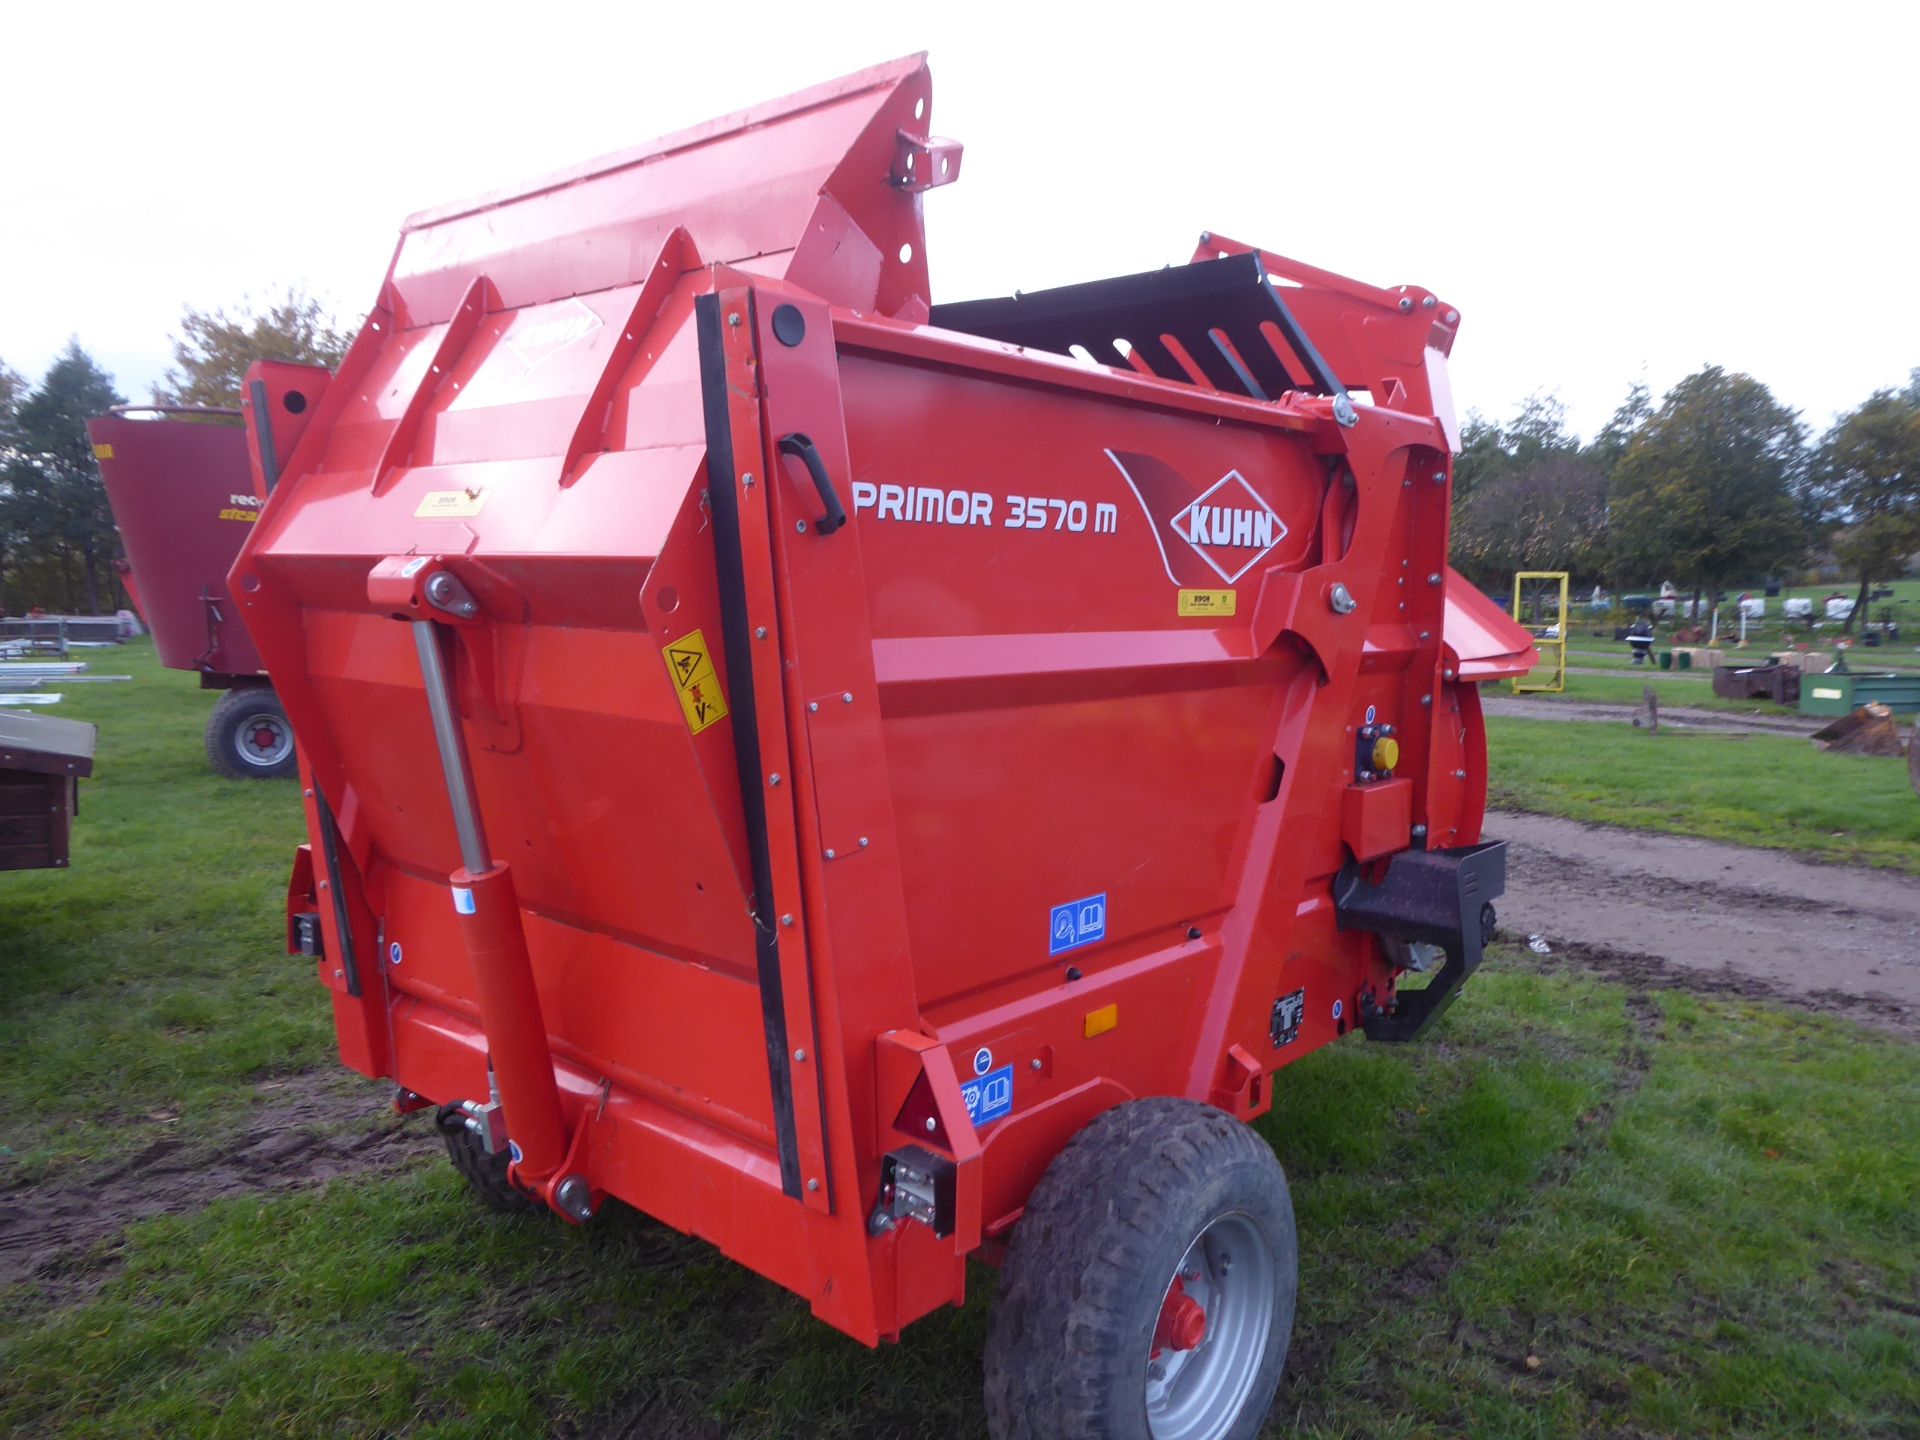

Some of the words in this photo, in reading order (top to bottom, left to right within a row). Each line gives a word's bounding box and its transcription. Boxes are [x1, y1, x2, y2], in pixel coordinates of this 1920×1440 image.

[852, 481, 992, 527] PRIMOR
[1004, 495, 1088, 532] 3570
[1190, 505, 1272, 548] KUHN
